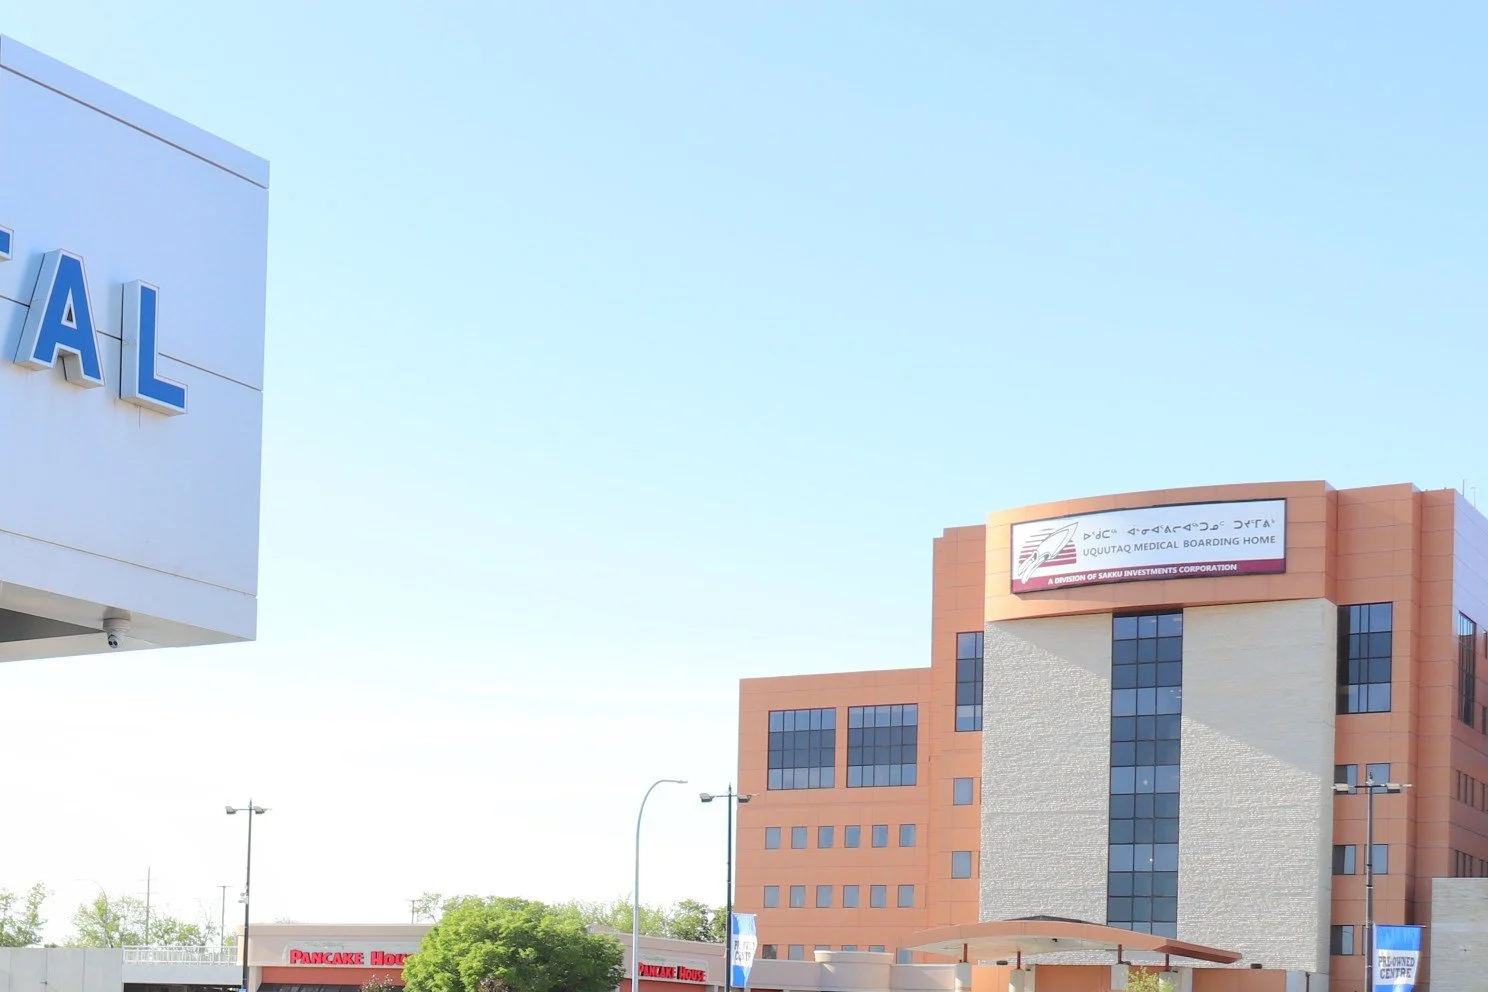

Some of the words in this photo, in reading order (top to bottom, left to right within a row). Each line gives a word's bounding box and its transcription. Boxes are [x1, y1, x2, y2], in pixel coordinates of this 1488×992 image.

[1083, 546, 1131, 558] UQUUTAQ
[1133, 541, 1179, 552] MEDICAL
[1183, 537, 1240, 549] BOARDING
[1243, 535, 1276, 545] HOME
[1048, 577, 1053, 585] A
[1054, 575, 1086, 584] DIVISION
[1098, 571, 1123, 579] SAKKU
[1124, 566, 1178, 577] INVESTMENTS
[1179, 564, 1237, 573] CORPORATION
[290, 949, 364, 965] PANCAKE
[370, 950, 413, 966] HOU
[1378, 955, 1415, 968] PRE-OWNED
[638, 961, 677, 979] PANCAKE
[677, 965, 707, 982] HOUSE
[1379, 967, 1412, 980] CENTRE
